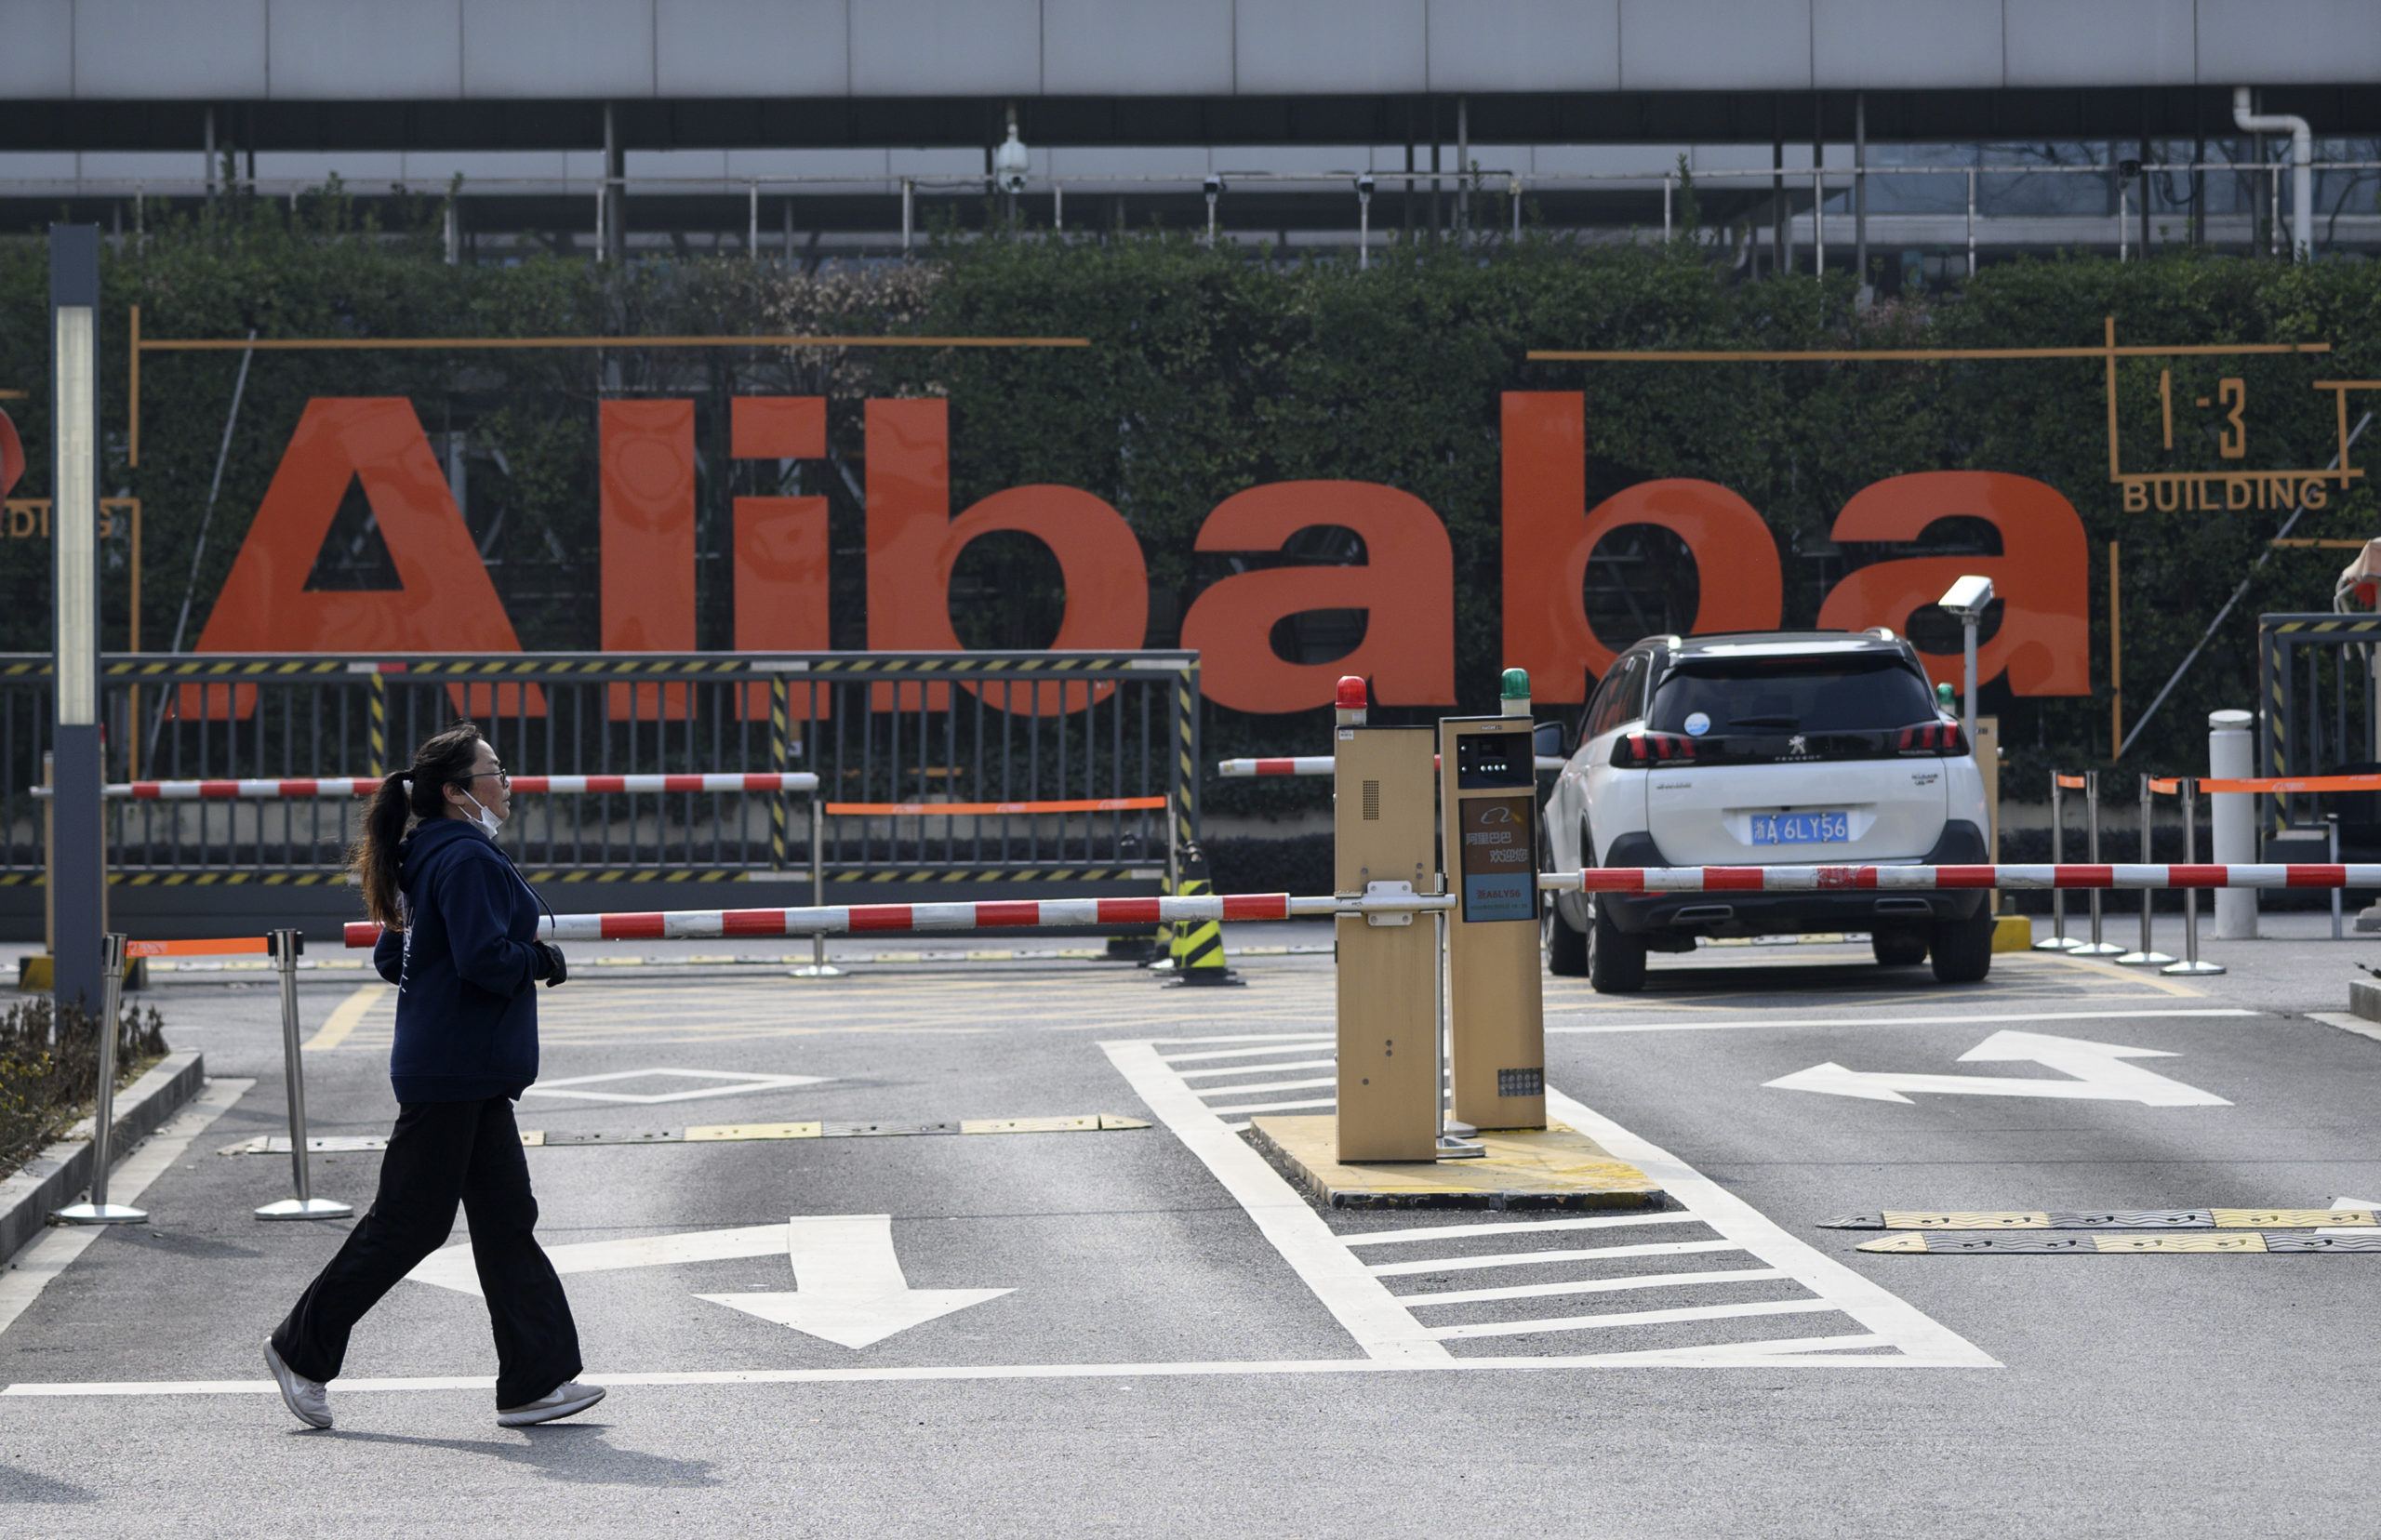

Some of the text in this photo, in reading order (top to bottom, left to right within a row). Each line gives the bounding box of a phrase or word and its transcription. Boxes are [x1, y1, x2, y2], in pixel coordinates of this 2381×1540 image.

[2122, 477, 2328, 513] BUILDING
[166, 391, 2094, 722] Alibaba
[1466, 831, 1512, 845] 阿里巴巴
[1489, 847, 1529, 863] 欢迎您
